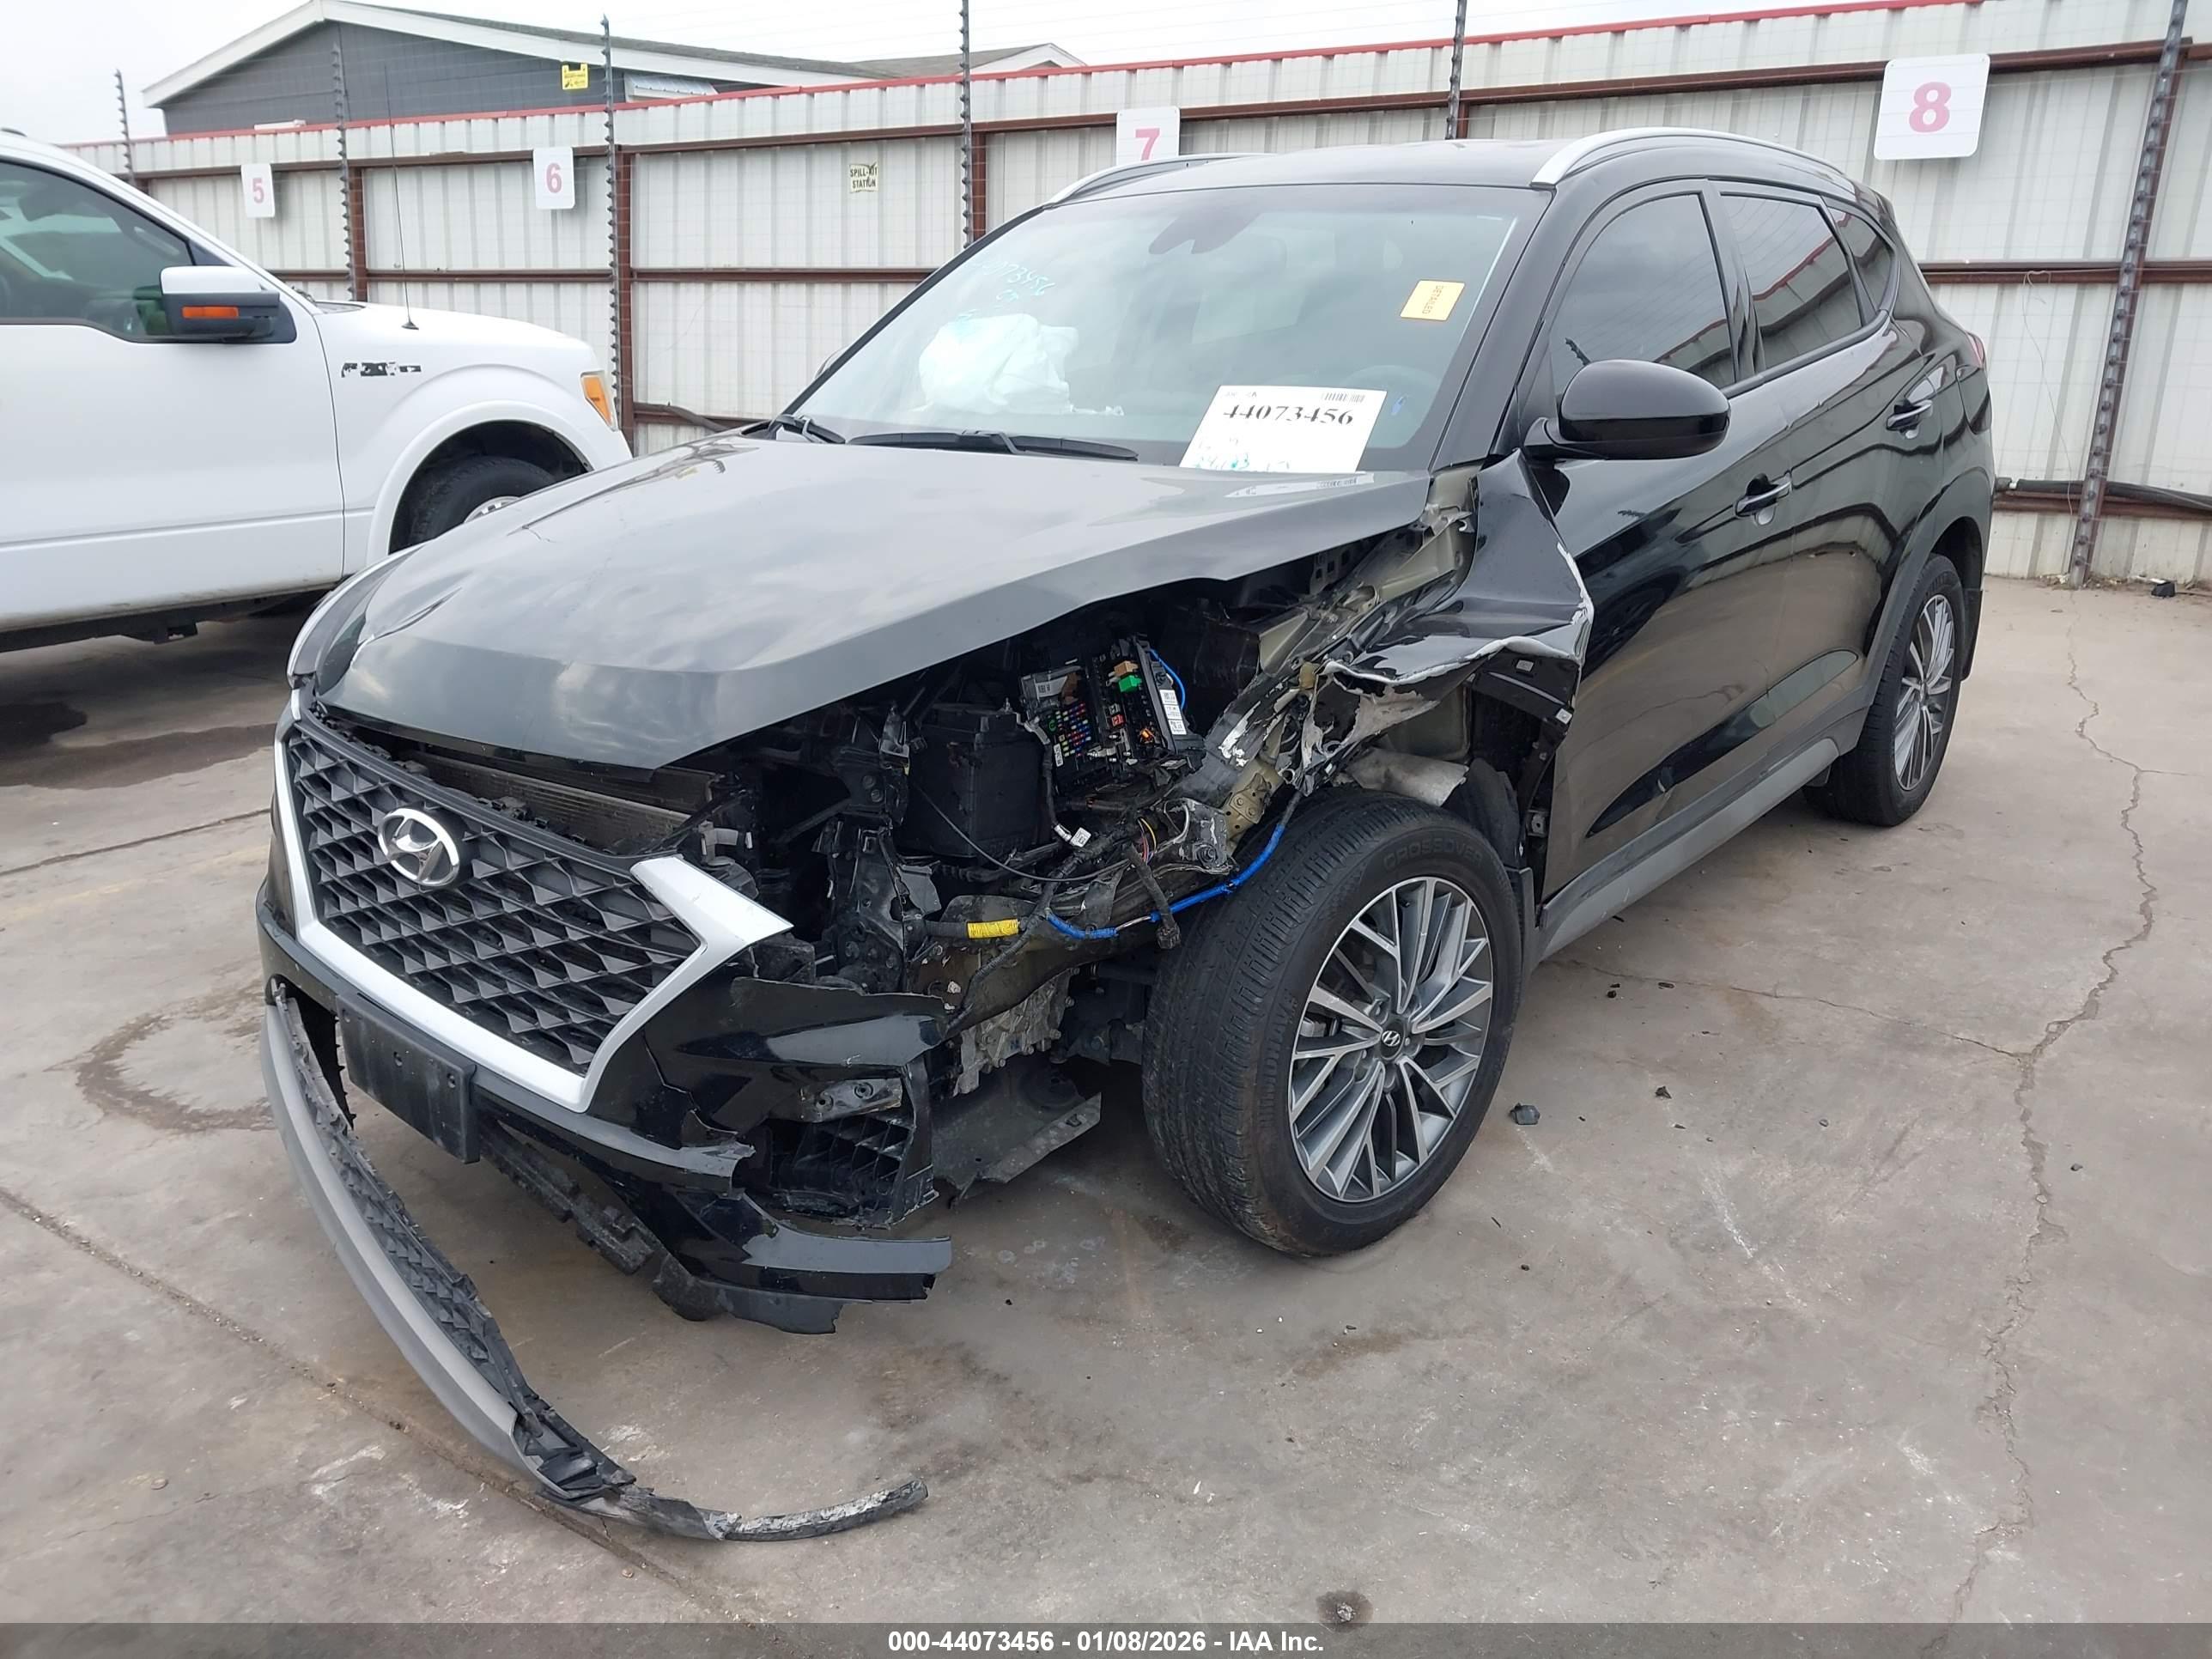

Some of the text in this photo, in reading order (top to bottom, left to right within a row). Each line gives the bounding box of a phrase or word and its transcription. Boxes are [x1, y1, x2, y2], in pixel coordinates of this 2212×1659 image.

[1908, 82, 1952, 133] 8
[1134, 127, 1160, 161] 7
[252, 177, 264, 204] 5
[545, 162, 562, 194] 6
[969, 260, 1056, 296] 073456
[1223, 403, 1354, 426] 44073456
